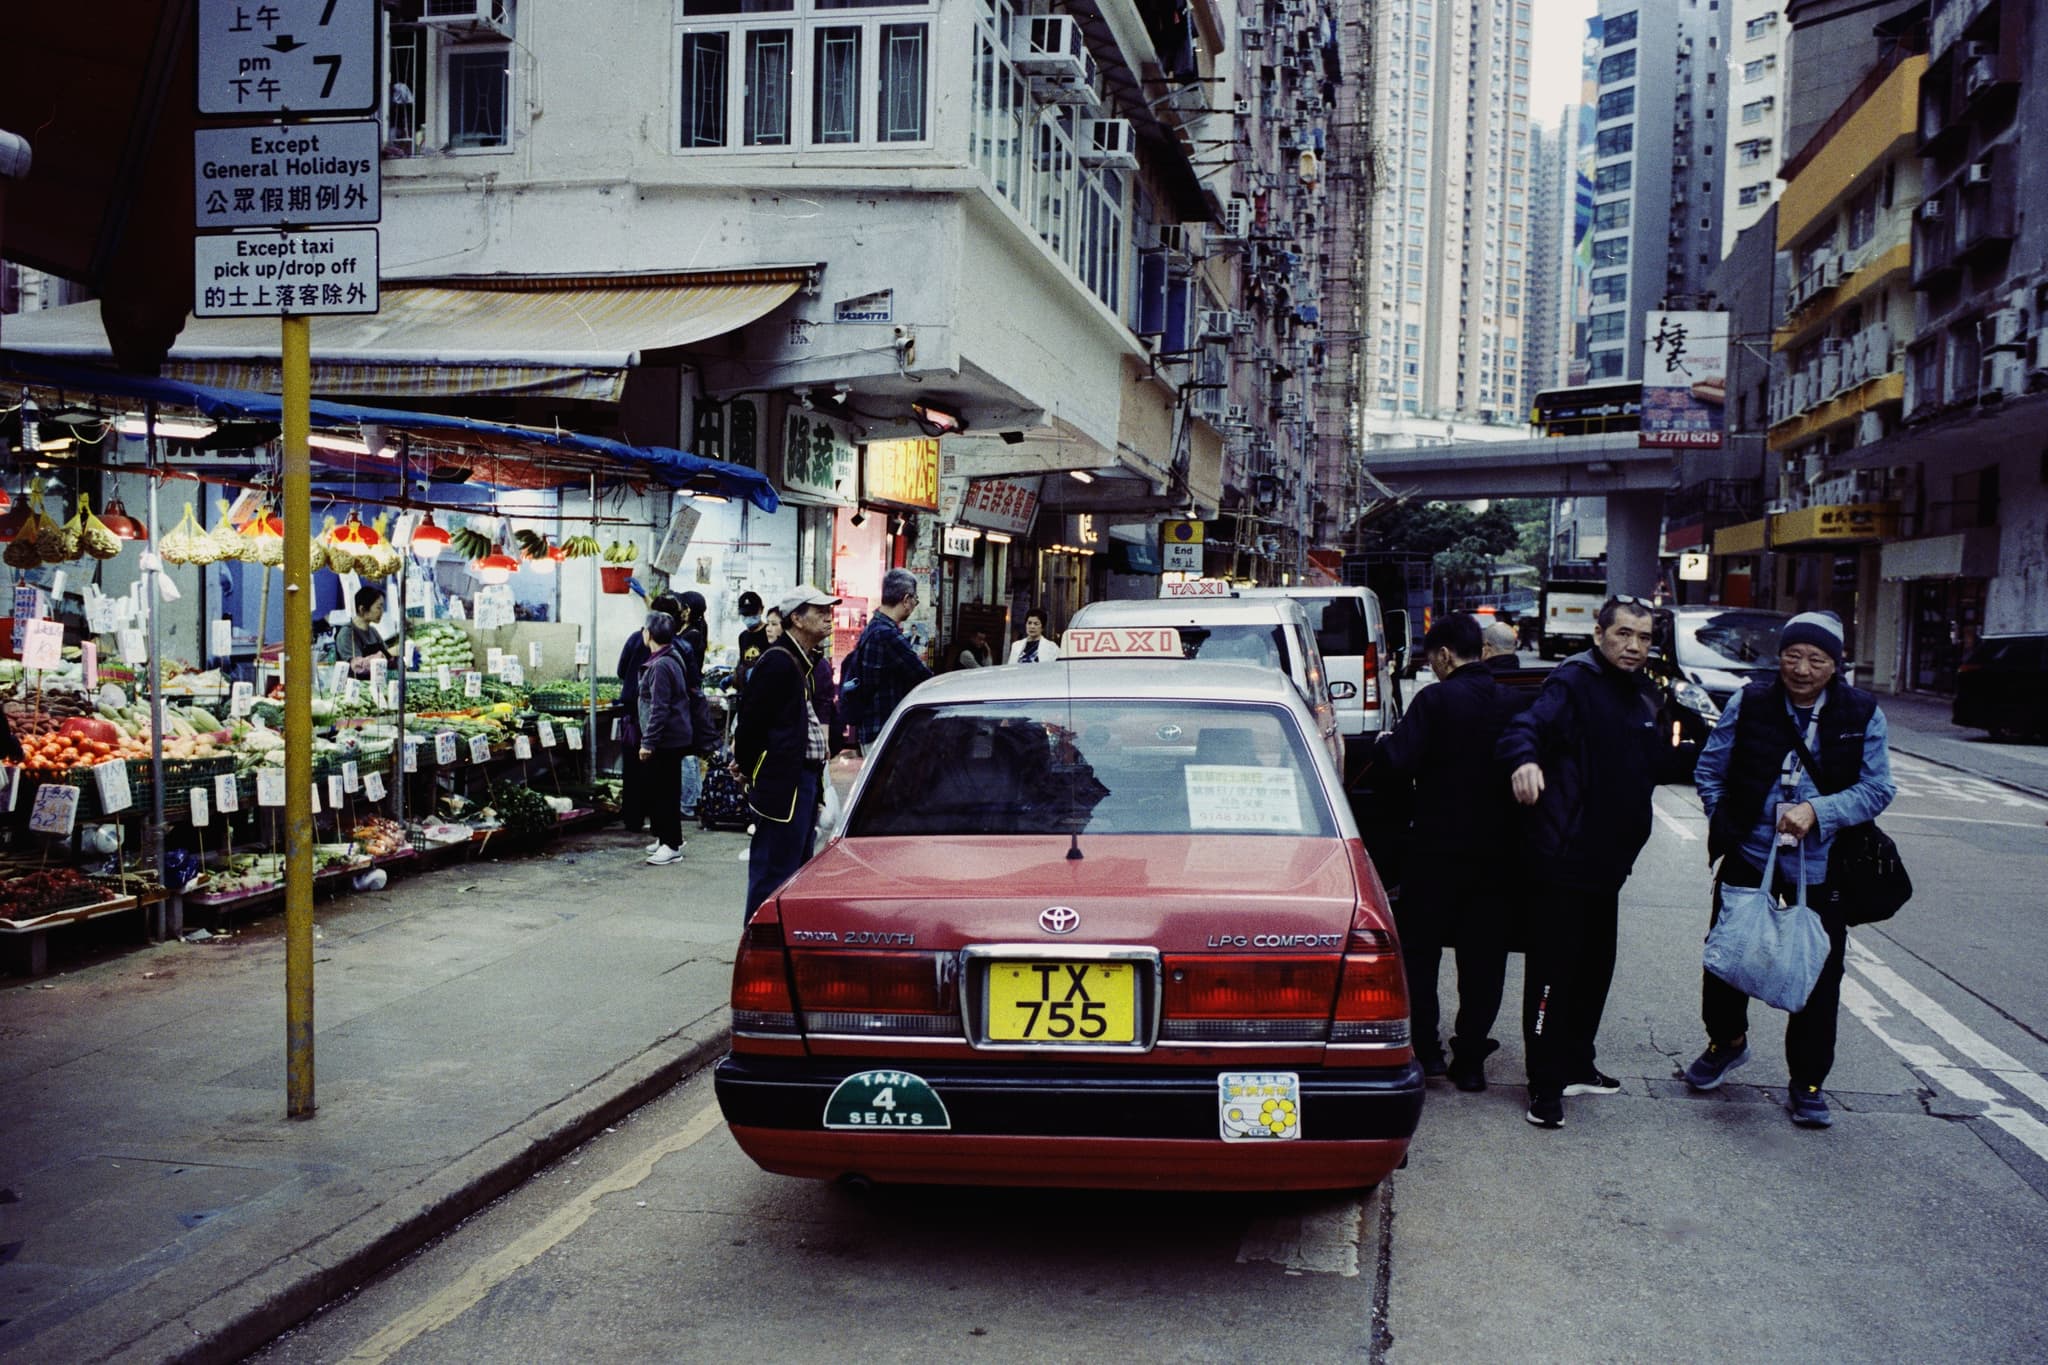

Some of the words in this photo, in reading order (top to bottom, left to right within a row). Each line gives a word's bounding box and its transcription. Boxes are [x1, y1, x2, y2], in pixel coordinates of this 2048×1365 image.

[228, 5, 280, 32] 上午
[239, 56, 271, 75] pm
[313, 54, 342, 99] 7
[228, 77, 281, 104] 下午
[251, 135, 320, 155] Except
[203, 159, 279, 180] General
[286, 157, 371, 177] Holidays
[206, 183, 369, 215] 公眾假期例外
[237, 240, 297, 258] Except
[301, 238, 334, 254] taxi
[214, 261, 250, 280] pick
[255, 260, 325, 280] up/drop
[331, 258, 357, 275] off
[204, 282, 368, 309] 的士上落客除外
[1174, 546, 1193, 555] End
[1167, 582, 1224, 596] TAXI
[1070, 631, 1172, 653] TAXI
[793, 931, 838, 941] TOYOTA
[1207, 935, 1248, 947] LPG
[1253, 934, 1343, 947] COMFORT
[1031, 965, 1091, 1002] TX
[1015, 1001, 1108, 1039] 755
[860, 1073, 910, 1088] TAXI
[872, 1087, 897, 1111] 4
[849, 1112, 923, 1125] SEATS
